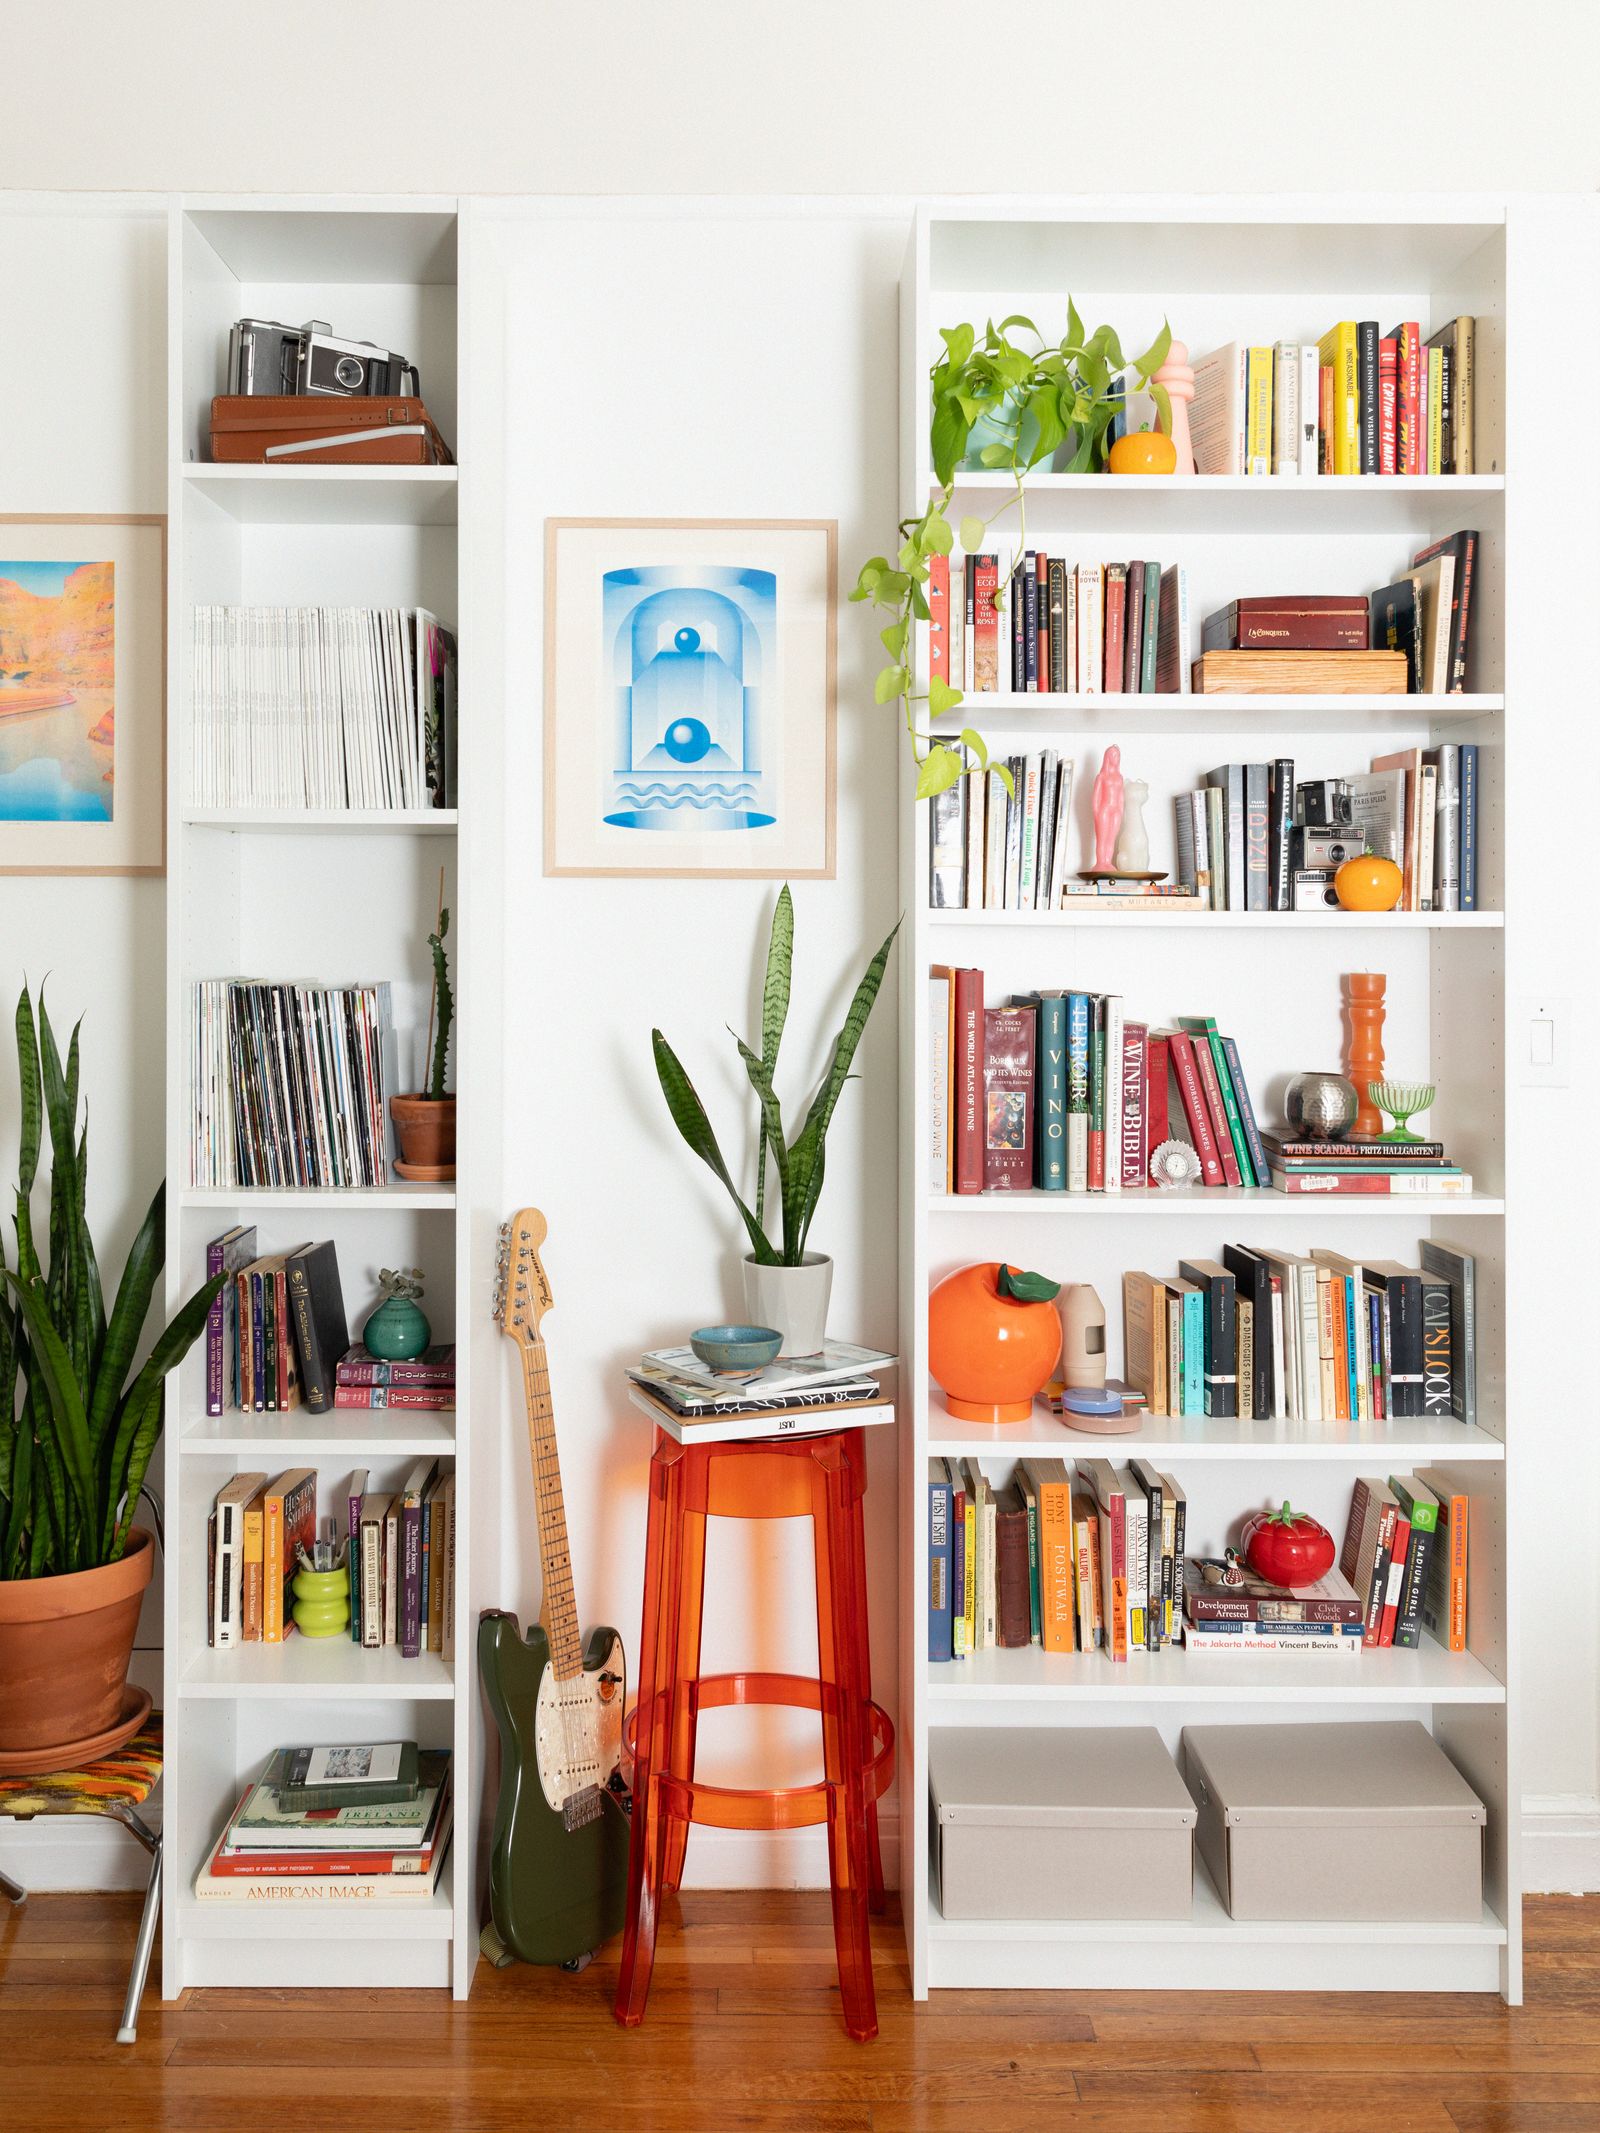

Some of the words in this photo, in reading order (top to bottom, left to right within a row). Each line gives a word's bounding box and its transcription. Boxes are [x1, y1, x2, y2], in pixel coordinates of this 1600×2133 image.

[1383, 382, 1394, 418] CRYING
[1385, 420, 1392, 430] IN
[1384, 432, 1394, 442] H
[1384, 443, 1394, 475] MART
[1028, 615, 1034, 623] OF
[1460, 610, 1468, 641] DOWNSTAIRS
[1248, 629, 1257, 638] LA
[1257, 628, 1290, 640] CONQUISTA
[1028, 771, 1036, 794] Quick
[1027, 795, 1035, 815] Fixes
[1071, 1004, 1087, 1100] TERROIR
[1010, 1068, 1032, 1077] WINES
[1124, 1040, 1142, 1096] WINE
[1201, 1050, 1215, 1090] Understanding
[968, 1093, 974, 1106] OF
[1048, 1050, 1062, 1138] VINO
[1211, 1090, 1219, 1104] Wine
[1228, 1044, 1237, 1067] FEIRING
[1236, 1077, 1245, 1103] NATURAL
[1242, 1104, 1251, 1118] WINE
[1253, 1144, 1263, 1166] PEOPLE
[1184, 1065, 1203, 1120] GODFORSAKEN
[1199, 1122, 1210, 1151] GRAPES
[1214, 1106, 1226, 1136] Technology
[1123, 1114, 1142, 1177] BIBLE
[1286, 1144, 1312, 1155] WINE
[1314, 1144, 1359, 1155] SCANDAL
[1360, 1144, 1382, 1154] FRITZ
[1383, 1144, 1433, 1155] HALLGARTEN
[300, 1311, 308, 1336] Children
[1425, 1292, 1451, 1345] CAPS
[1244, 1371, 1251, 1380] OF
[1425, 1350, 1451, 1408] LOCK
[778, 1420, 796, 1430] DUST
[933, 1497, 945, 1519] LAST
[1129, 1515, 1136, 1526] AN
[1138, 1514, 1148, 1548] JAPAN
[1377, 1517, 1387, 1546] Flower
[1386, 1510, 1395, 1536] Killers
[933, 1521, 945, 1544] TSAR
[410, 1553, 418, 1575] Journey
[1079, 1548, 1088, 1582] GALLIPOLI
[1138, 1552, 1147, 1562] AT
[1374, 1546, 1382, 1568] Moon
[1414, 1545, 1425, 1583] RADIUM
[1055, 1545, 1066, 1621] POSTWAR
[1138, 1562, 1147, 1590] WAR
[1198, 1601, 1249, 1612] Development
[1216, 1610, 1249, 1618] Arrested
[1318, 1604, 1340, 1614] Clyde
[1409, 1588, 1419, 1617] GIRLS
[1314, 1612, 1341, 1621] Woods
[1370, 1604, 1378, 1628] Grann
[247, 1886, 324, 1898] AMERICAN
[328, 1886, 376, 1898] IMAGE
